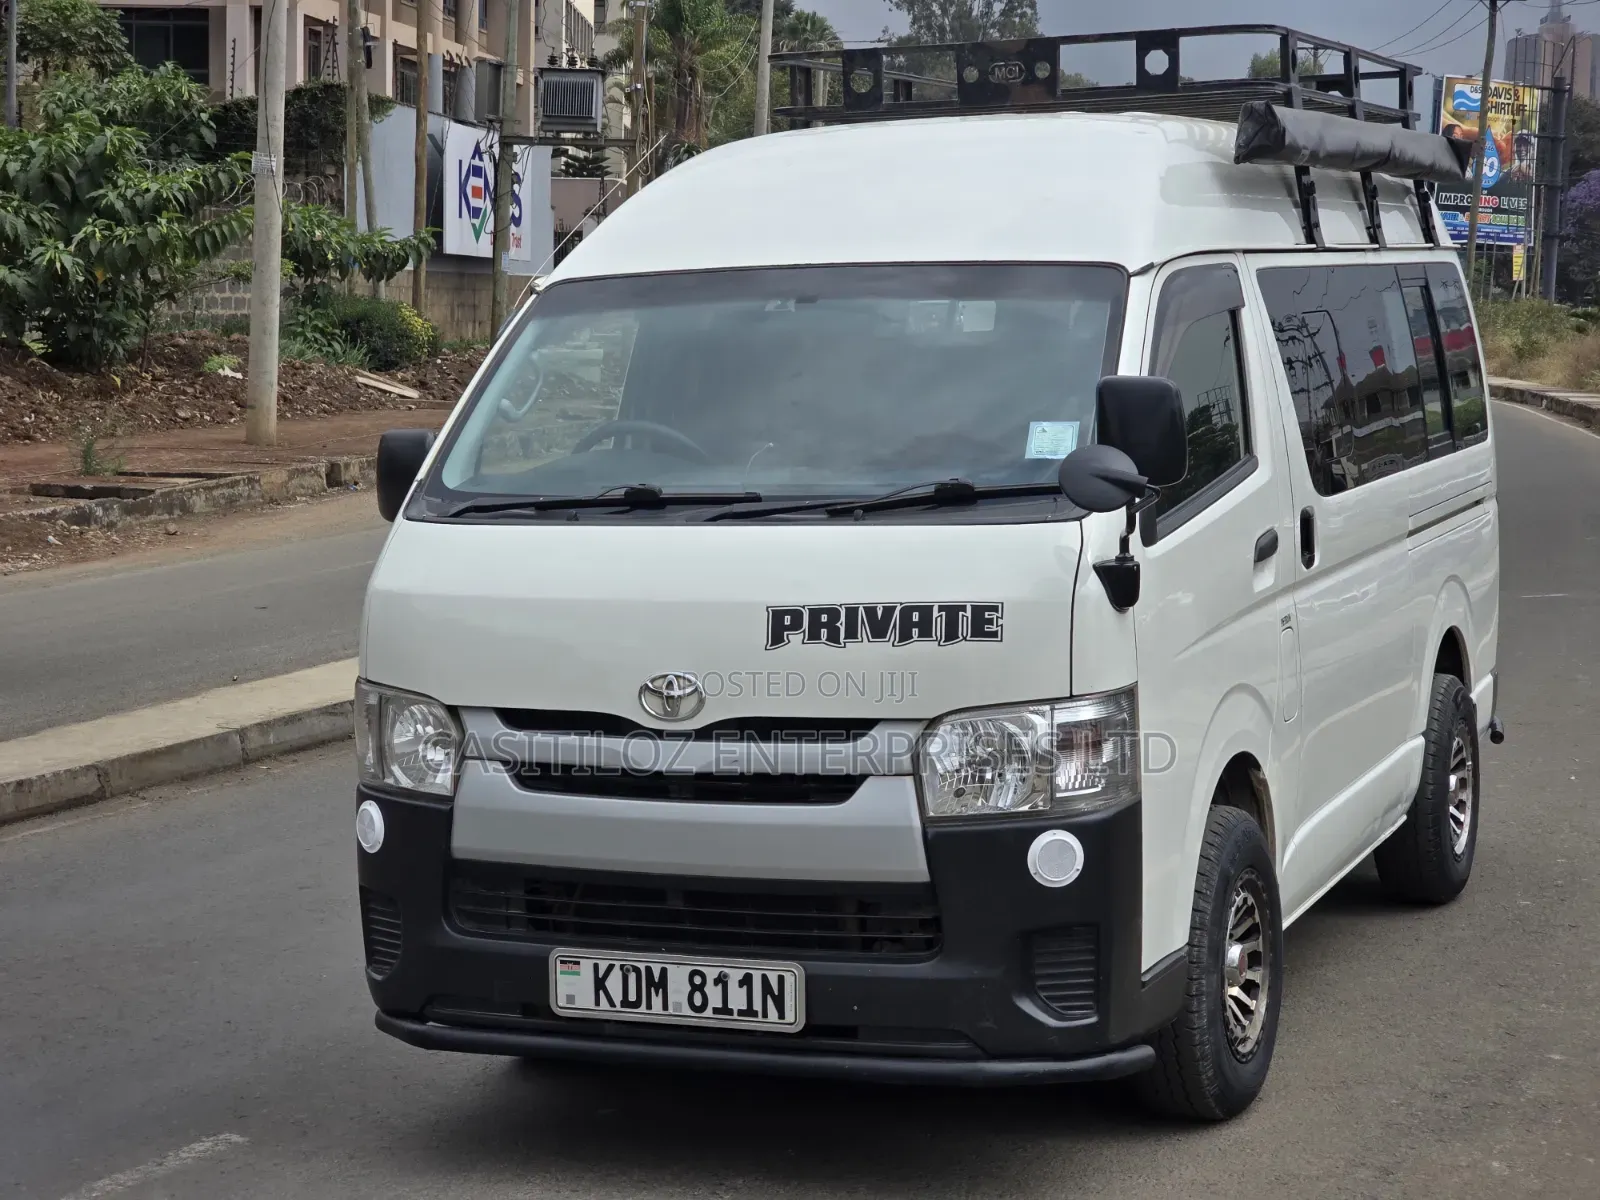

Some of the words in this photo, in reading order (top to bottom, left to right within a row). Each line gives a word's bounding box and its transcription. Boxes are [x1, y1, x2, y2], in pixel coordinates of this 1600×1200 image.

[994, 66, 1020, 79] MCI
[1488, 86, 1512, 100] DAVIS
[459, 152, 522, 230] KENS
[1439, 192, 1499, 207] IMPROING
[1501, 197, 1527, 209] LIVES
[766, 602, 1004, 650] PRIVATE
[593, 961, 669, 1012] KDM
[687, 968, 786, 1021] 811N
